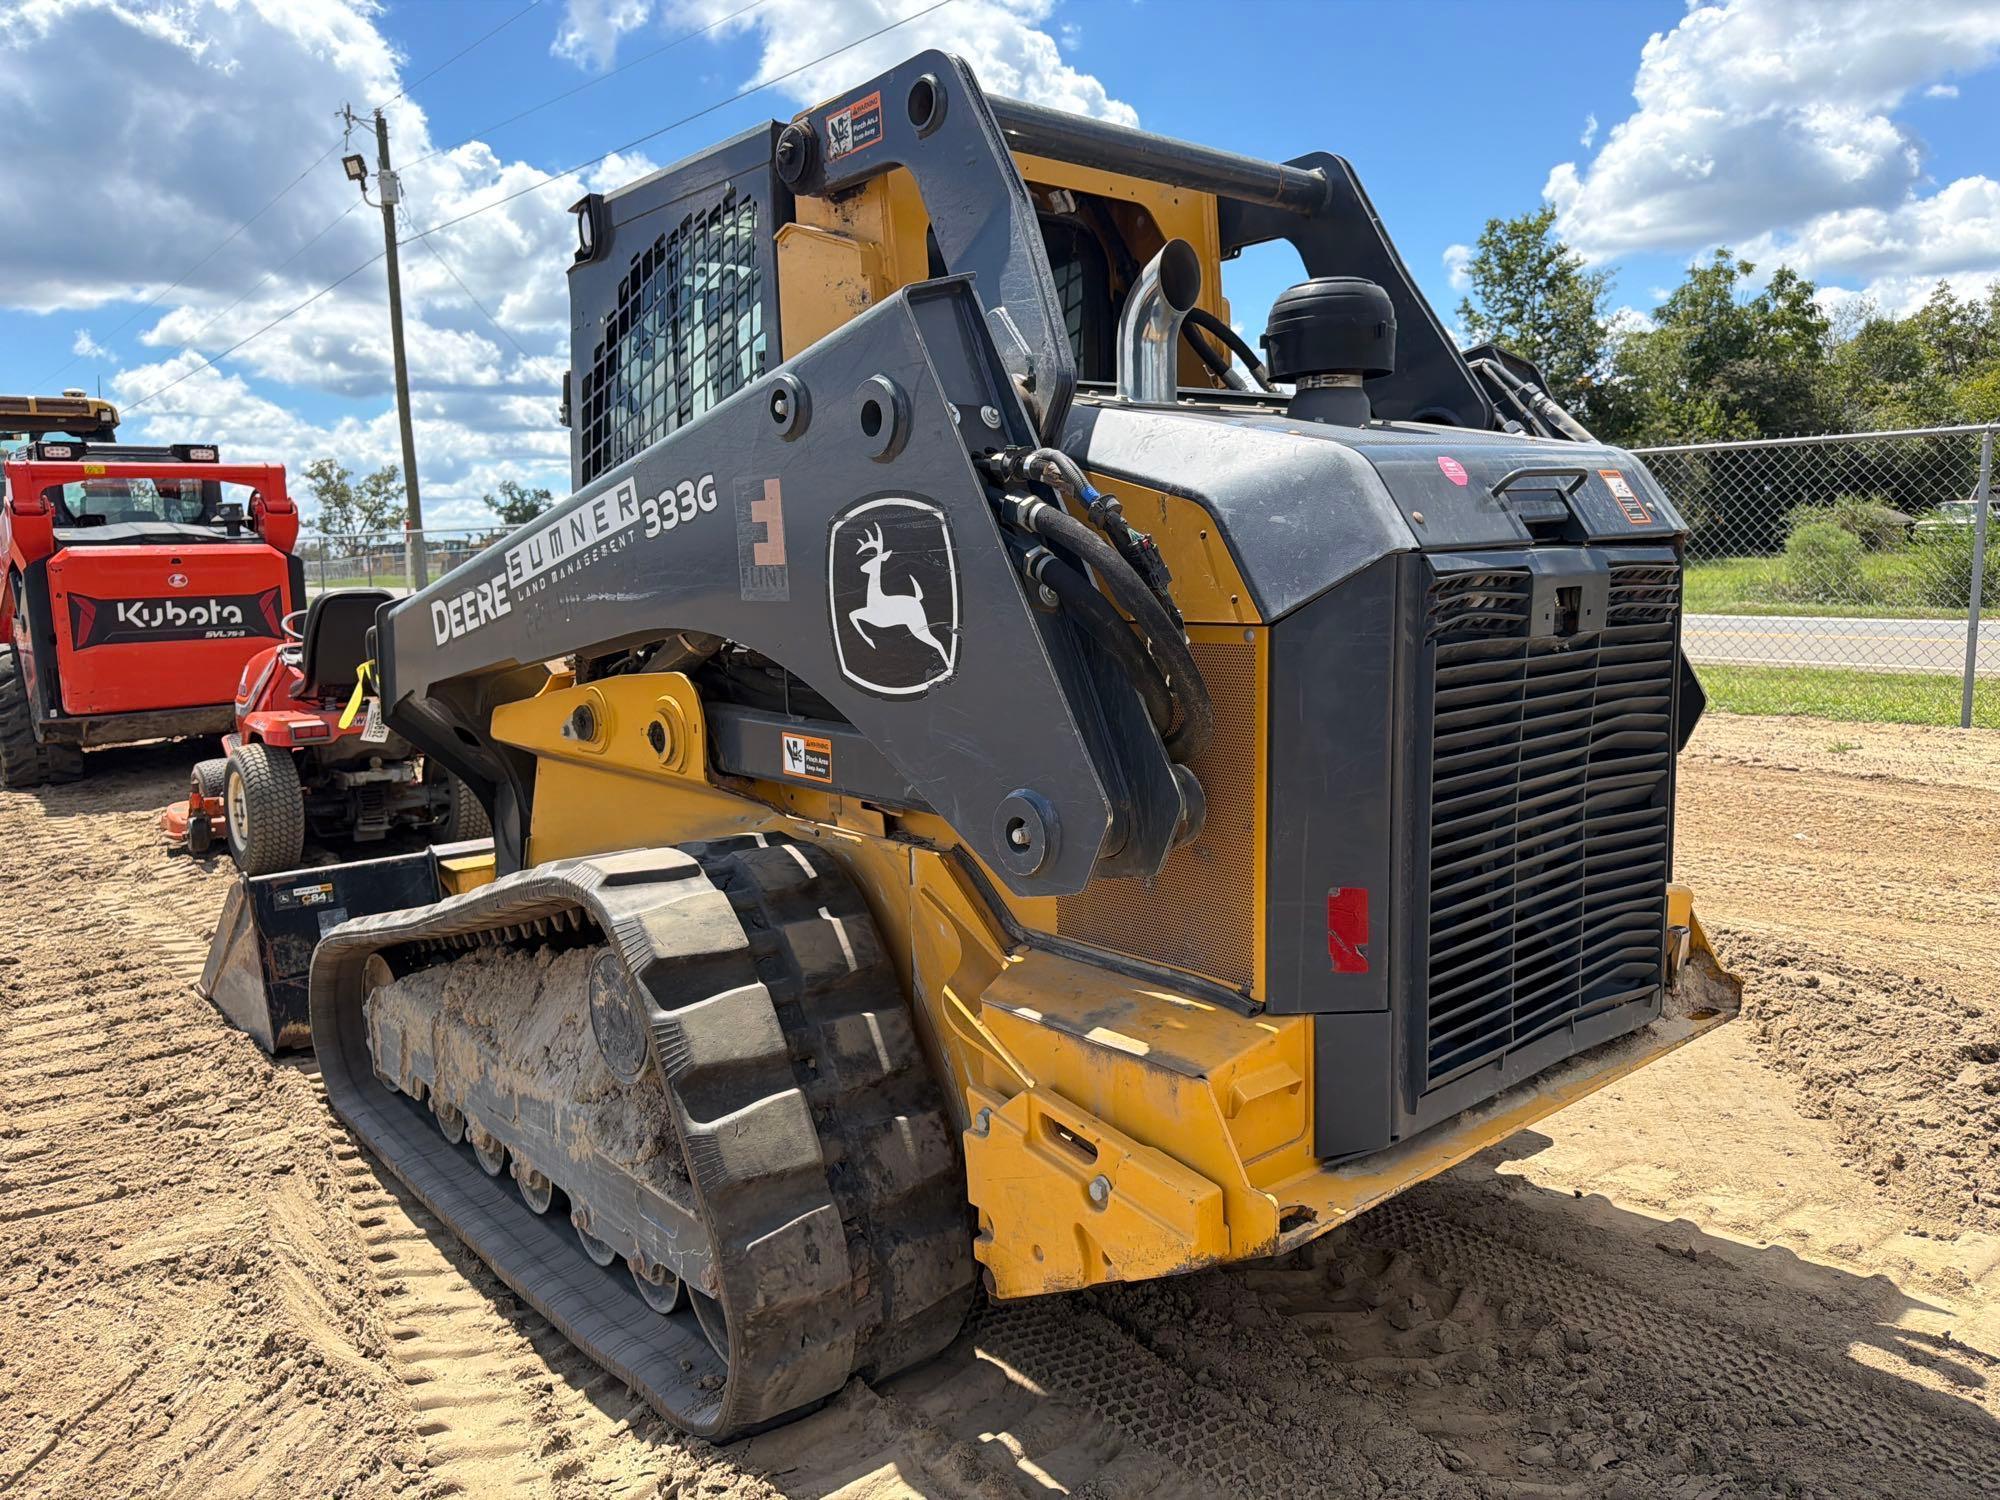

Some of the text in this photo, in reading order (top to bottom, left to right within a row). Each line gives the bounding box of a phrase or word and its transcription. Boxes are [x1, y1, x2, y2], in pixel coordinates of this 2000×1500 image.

[507, 482, 639, 583] SUMNER
[642, 474, 719, 538] 333G
[518, 530, 635, 602] LAND MANAGEMENT
[117, 599, 243, 628] Kubota
[430, 573, 512, 646] DEERE
[806, 755, 829, 766] Pinch Area
